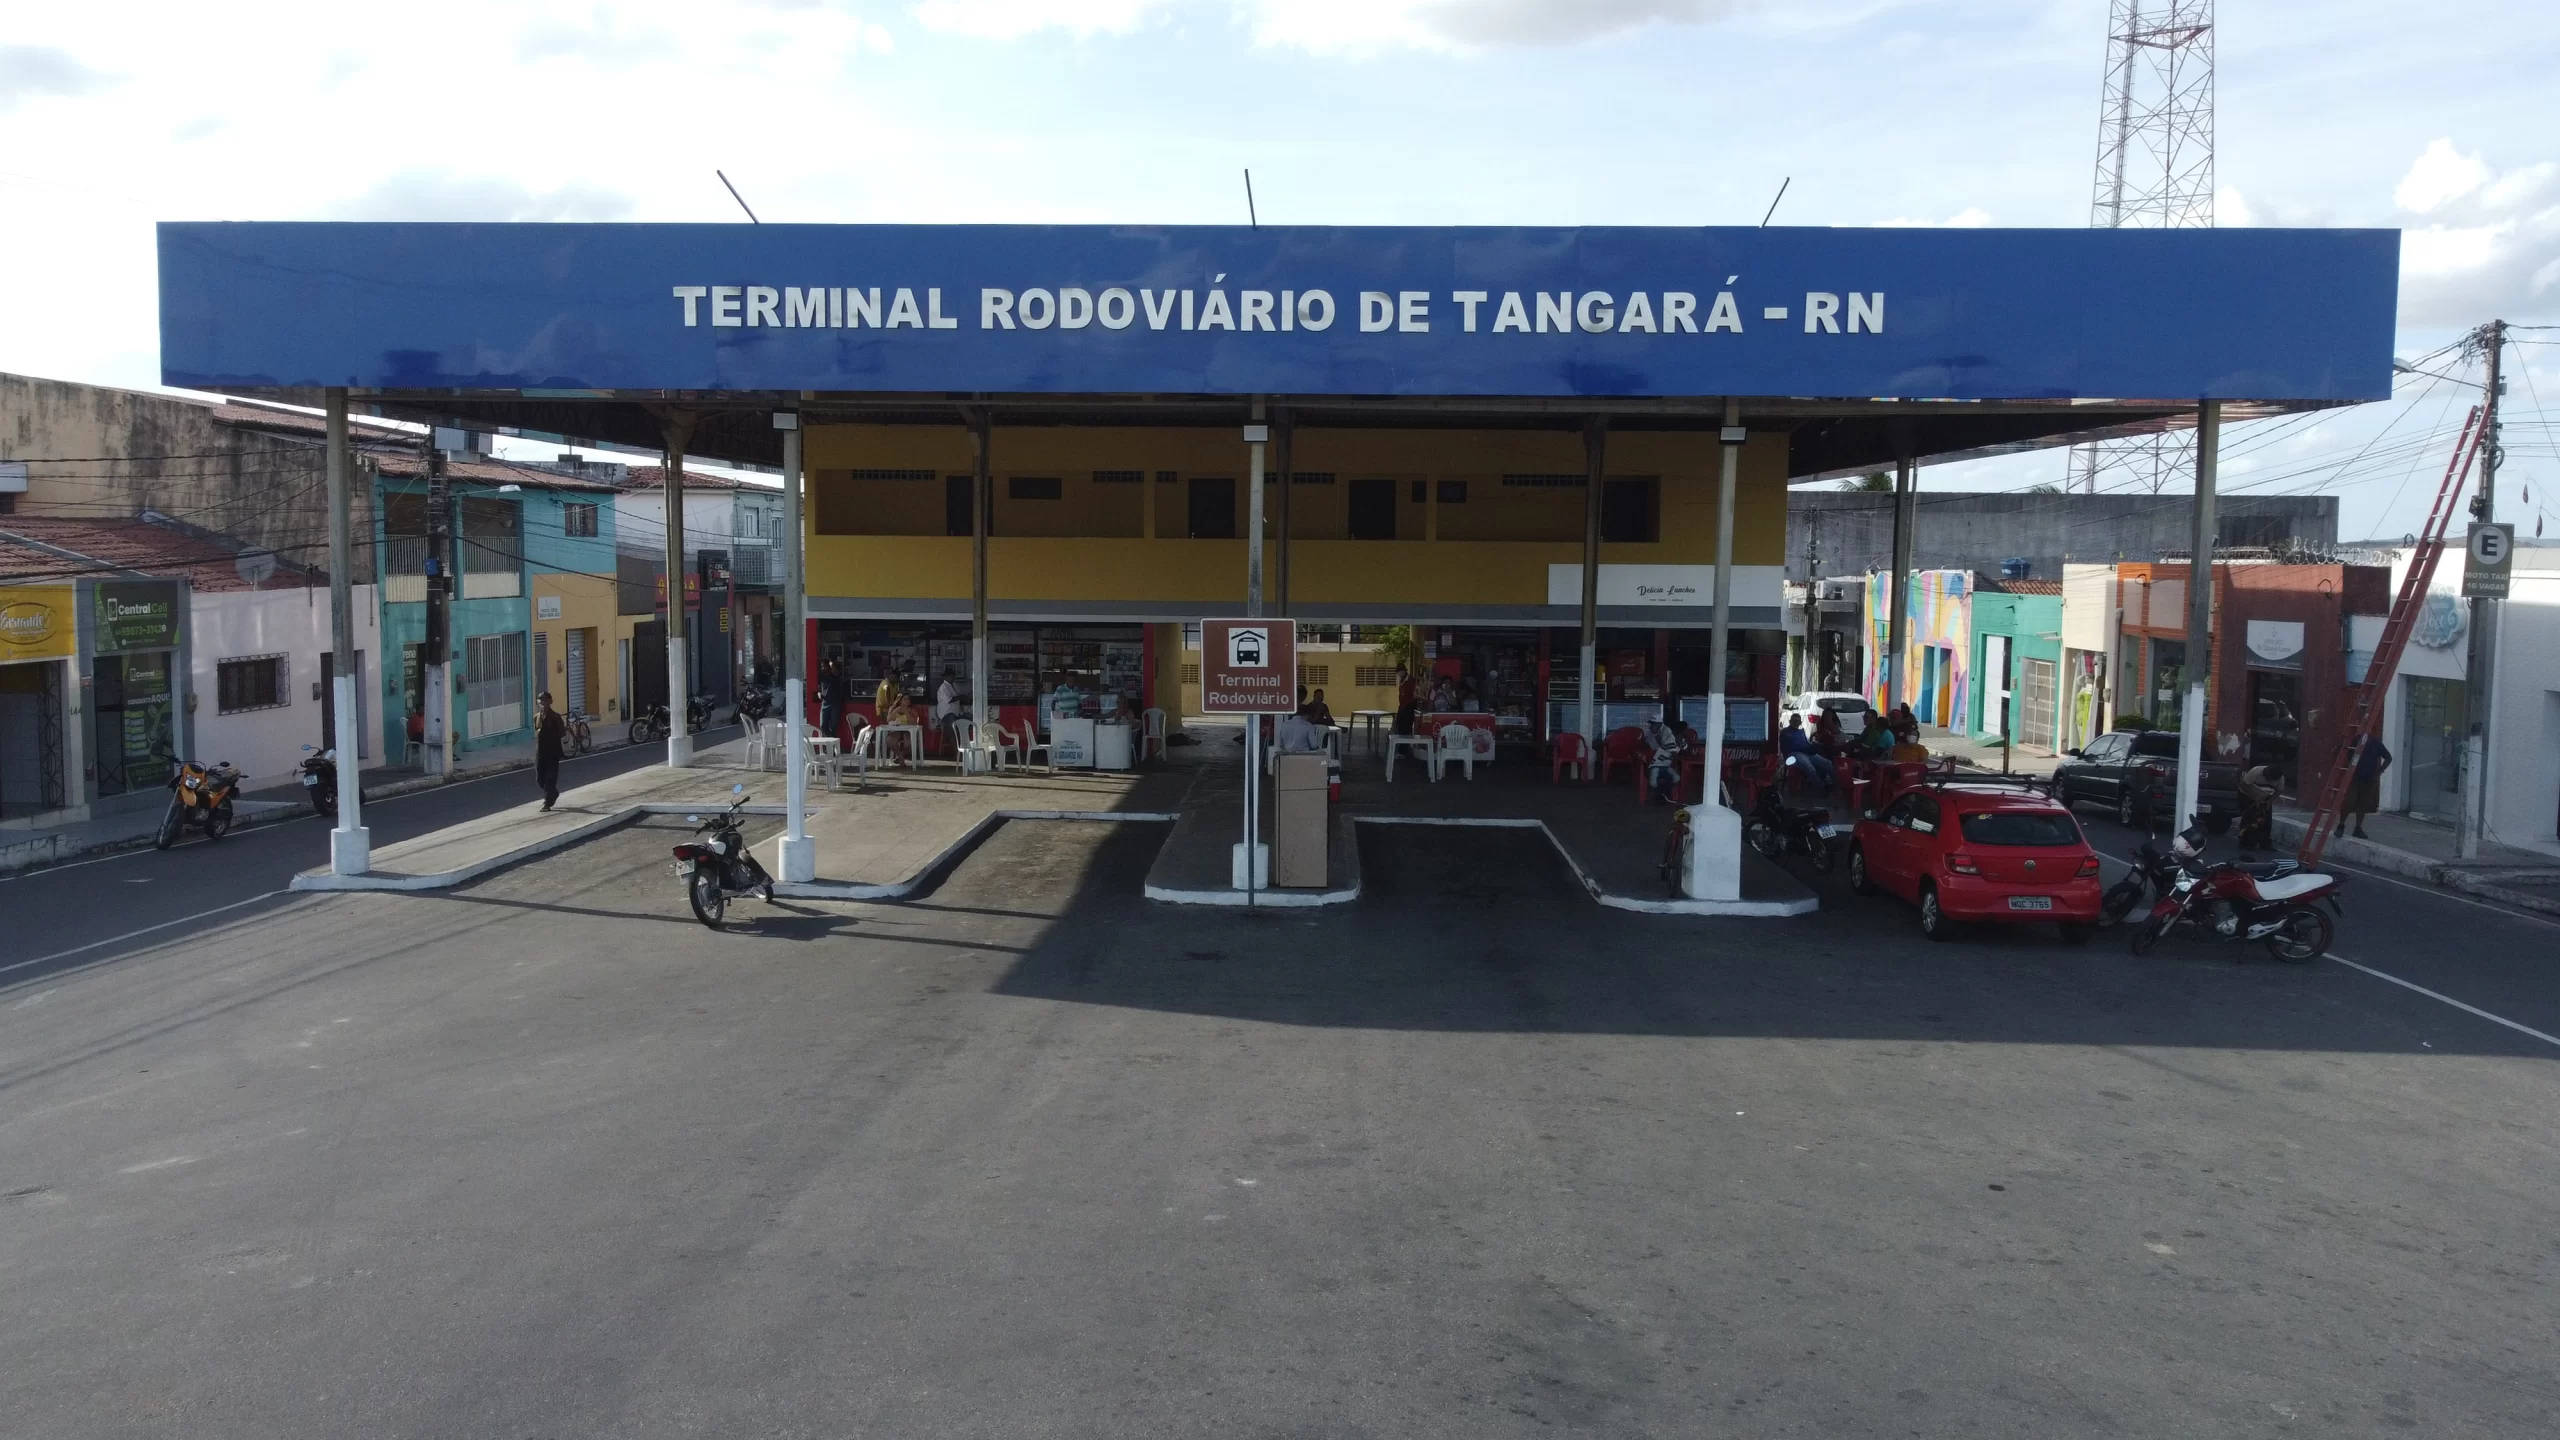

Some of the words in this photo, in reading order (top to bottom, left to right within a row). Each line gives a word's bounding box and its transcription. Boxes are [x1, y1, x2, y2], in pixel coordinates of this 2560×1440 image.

[674, 286, 957, 328] TERMINAL
[982, 274, 1335, 331] RODOVIÁRIO
[1360, 292, 1429, 332] DE
[1453, 276, 1742, 332] TANGARÁ
[1765, 307, 1787, 318] -
[1805, 293, 1883, 333] RN
[2481, 535, 2499, 556] E
[2480, 583, 2505, 591] VAGAS
[118, 602, 151, 616] Central
[151, 601, 168, 613] Cell
[1218, 674, 1281, 687] Terminal
[1209, 691, 1290, 705] Rodoviário
